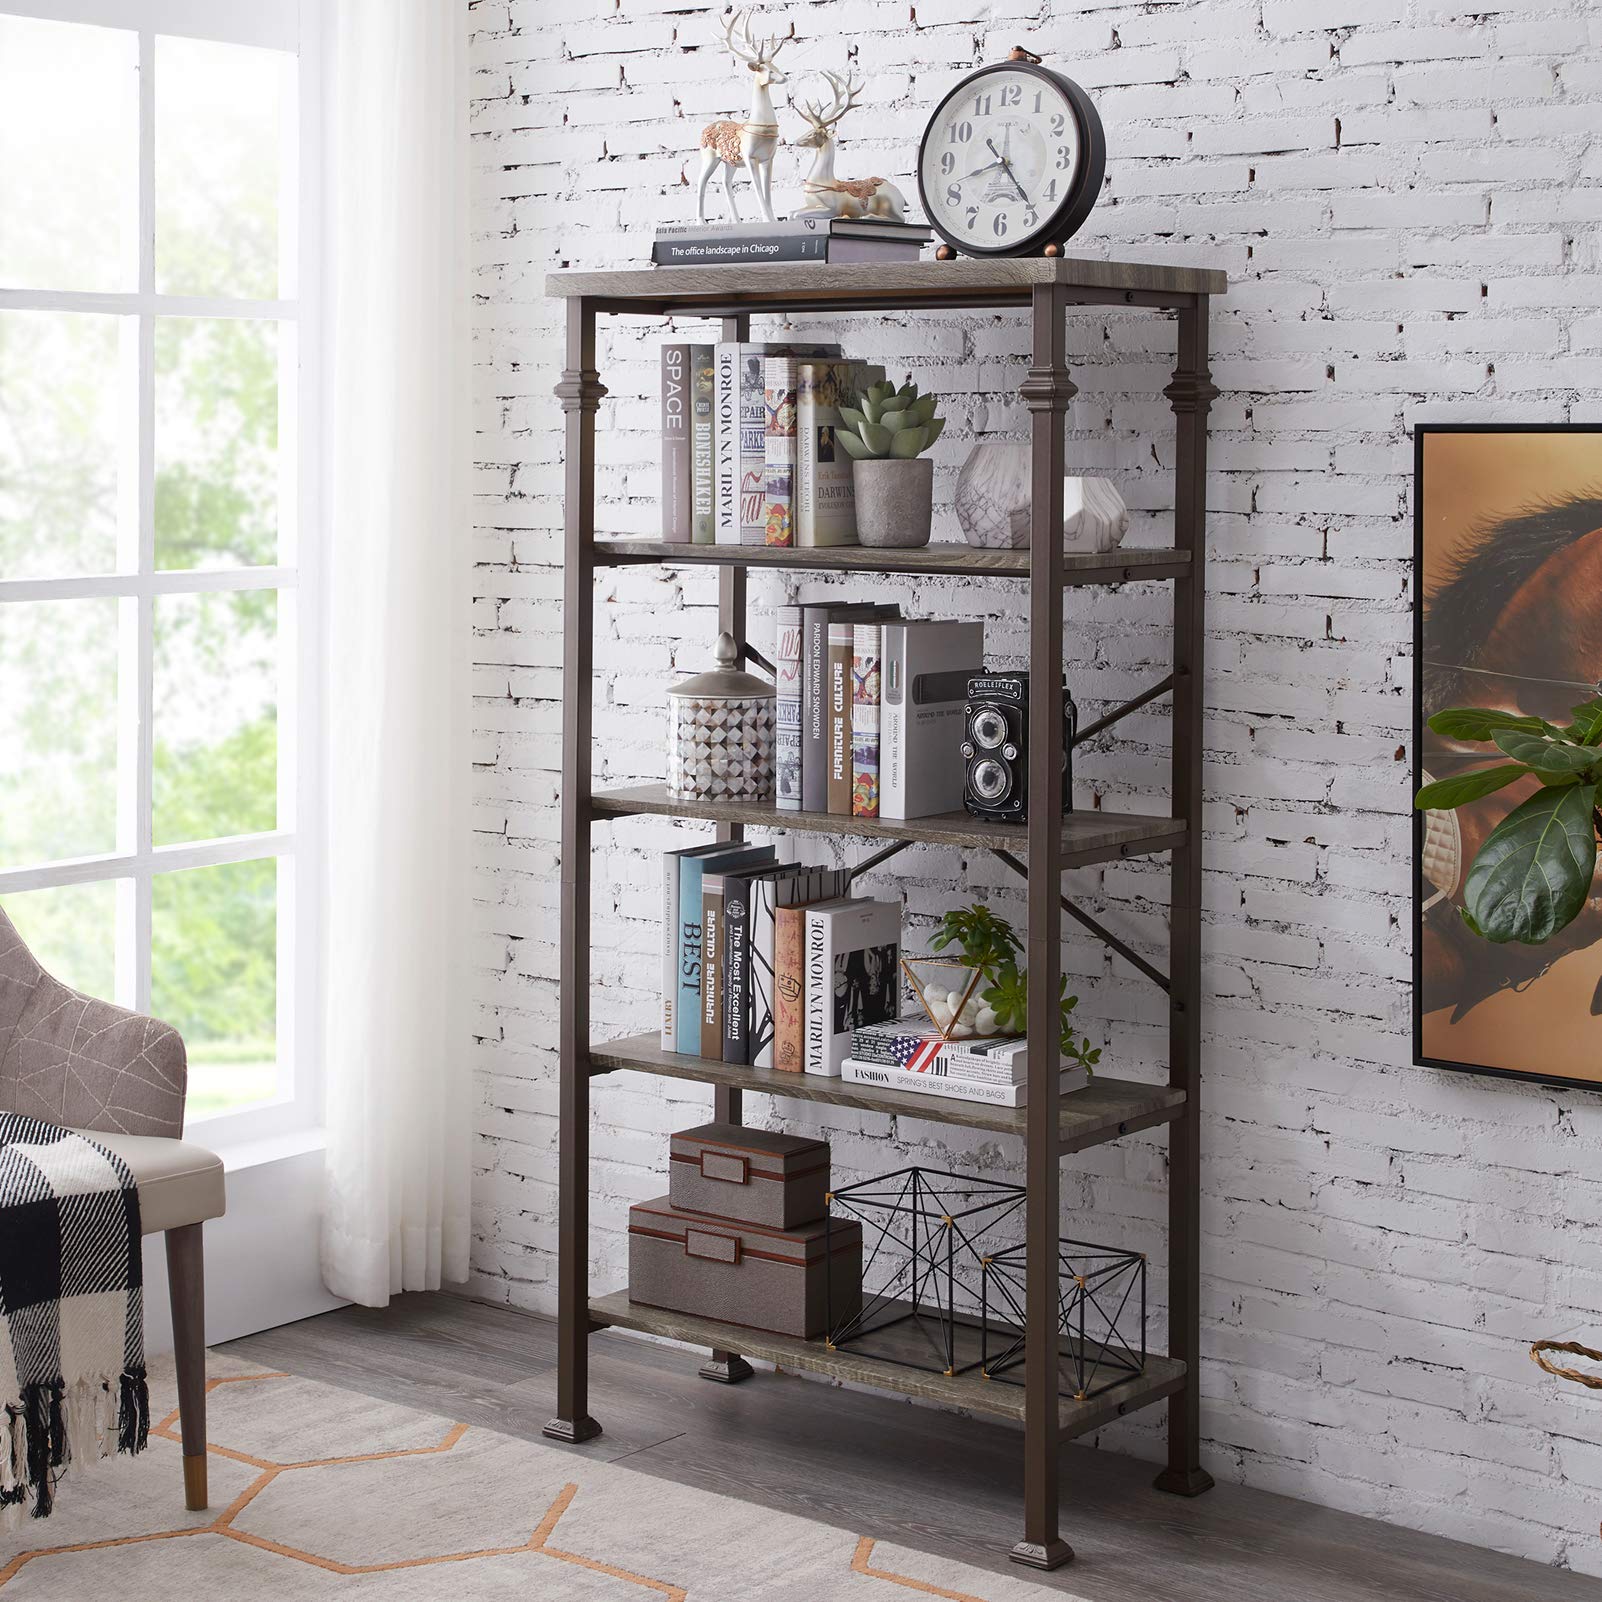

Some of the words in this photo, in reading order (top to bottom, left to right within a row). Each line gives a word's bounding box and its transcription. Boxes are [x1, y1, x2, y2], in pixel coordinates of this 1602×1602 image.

[974, 95, 992, 117] 11
[999, 85, 1022, 107] 12
[1032, 91, 1043, 113] 1
[948, 121, 972, 144] 10
[1049, 113, 1065, 138] 2
[941, 151, 956, 176] 9
[1055, 145, 1070, 170] 3
[946, 182, 962, 207] 8
[1042, 179, 1057, 201] 4
[965, 206, 980, 229] 7
[993, 212, 1007, 237] 6
[1022, 204, 1039, 228] 5
[671, 247, 684, 256] The
[685, 245, 705, 256] office
[705, 244, 741, 256] landscape
[742, 244, 749, 253] in
[750, 243, 780, 255] Chicago
[666, 350, 682, 429] SPACE
[721, 353, 733, 435] MONROE
[695, 422, 711, 516] BONESHAKER
[721, 440, 733, 528] MARILYN
[813, 623, 821, 657] PARDON
[834, 662, 843, 712] CULTURE
[812, 697, 820, 739] SNOWDEN
[833, 717, 843, 780] FURNITURE
[707, 910, 716, 959] CULTURE
[733, 925, 743, 947] The
[681, 922, 702, 997] BEST
[733, 951, 742, 981] Most
[810, 918, 824, 990] MONROE
[706, 963, 716, 1024] FURNITURE
[665, 1000, 673, 1036] LUXURY
[731, 984, 741, 1040] Excellent
[810, 994, 824, 1069] MARILYN
[855, 1069, 890, 1083] FASHION
[897, 1076, 927, 1089] SPRING'S
[929, 1081, 943, 1092] BEST
[945, 1084, 967, 1095] SHOES
[968, 1087, 984, 1097] AND
[985, 1090, 1006, 1101] BAGS
